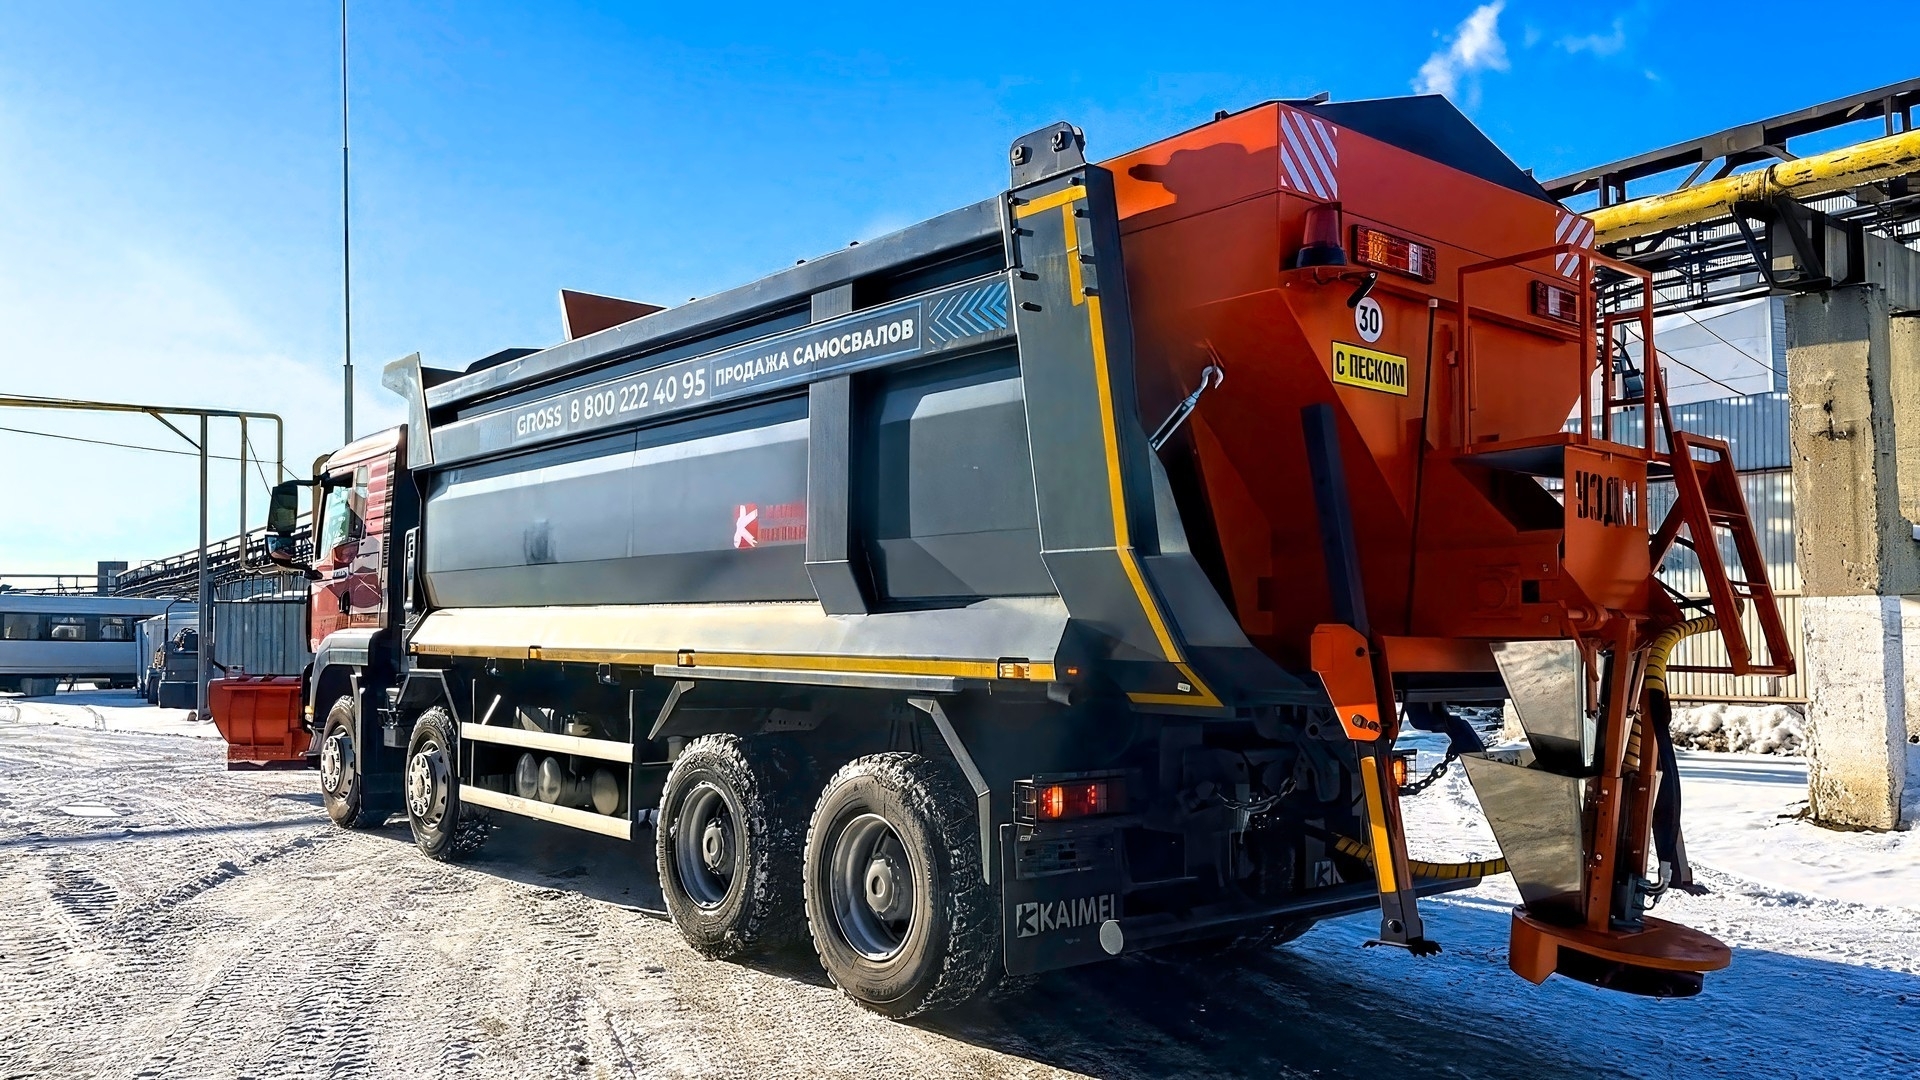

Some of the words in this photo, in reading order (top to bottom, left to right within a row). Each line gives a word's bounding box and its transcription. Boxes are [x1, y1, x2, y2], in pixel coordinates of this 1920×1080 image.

[1359, 305, 1379, 334] 30
[715, 352, 790, 387] ПРОДАЖА
[792, 318, 914, 366] САМОСВАЛОВ
[1336, 351, 1345, 375] С
[1349, 354, 1405, 387] ПЕСКОМ
[517, 404, 562, 436] GROSS
[570, 399, 579, 423] 8
[584, 390, 615, 420] 800
[619, 382, 649, 412] 222
[653, 375, 677, 405] 40
[682, 368, 706, 399] 95
[1040, 894, 1115, 932] KAIMEI
